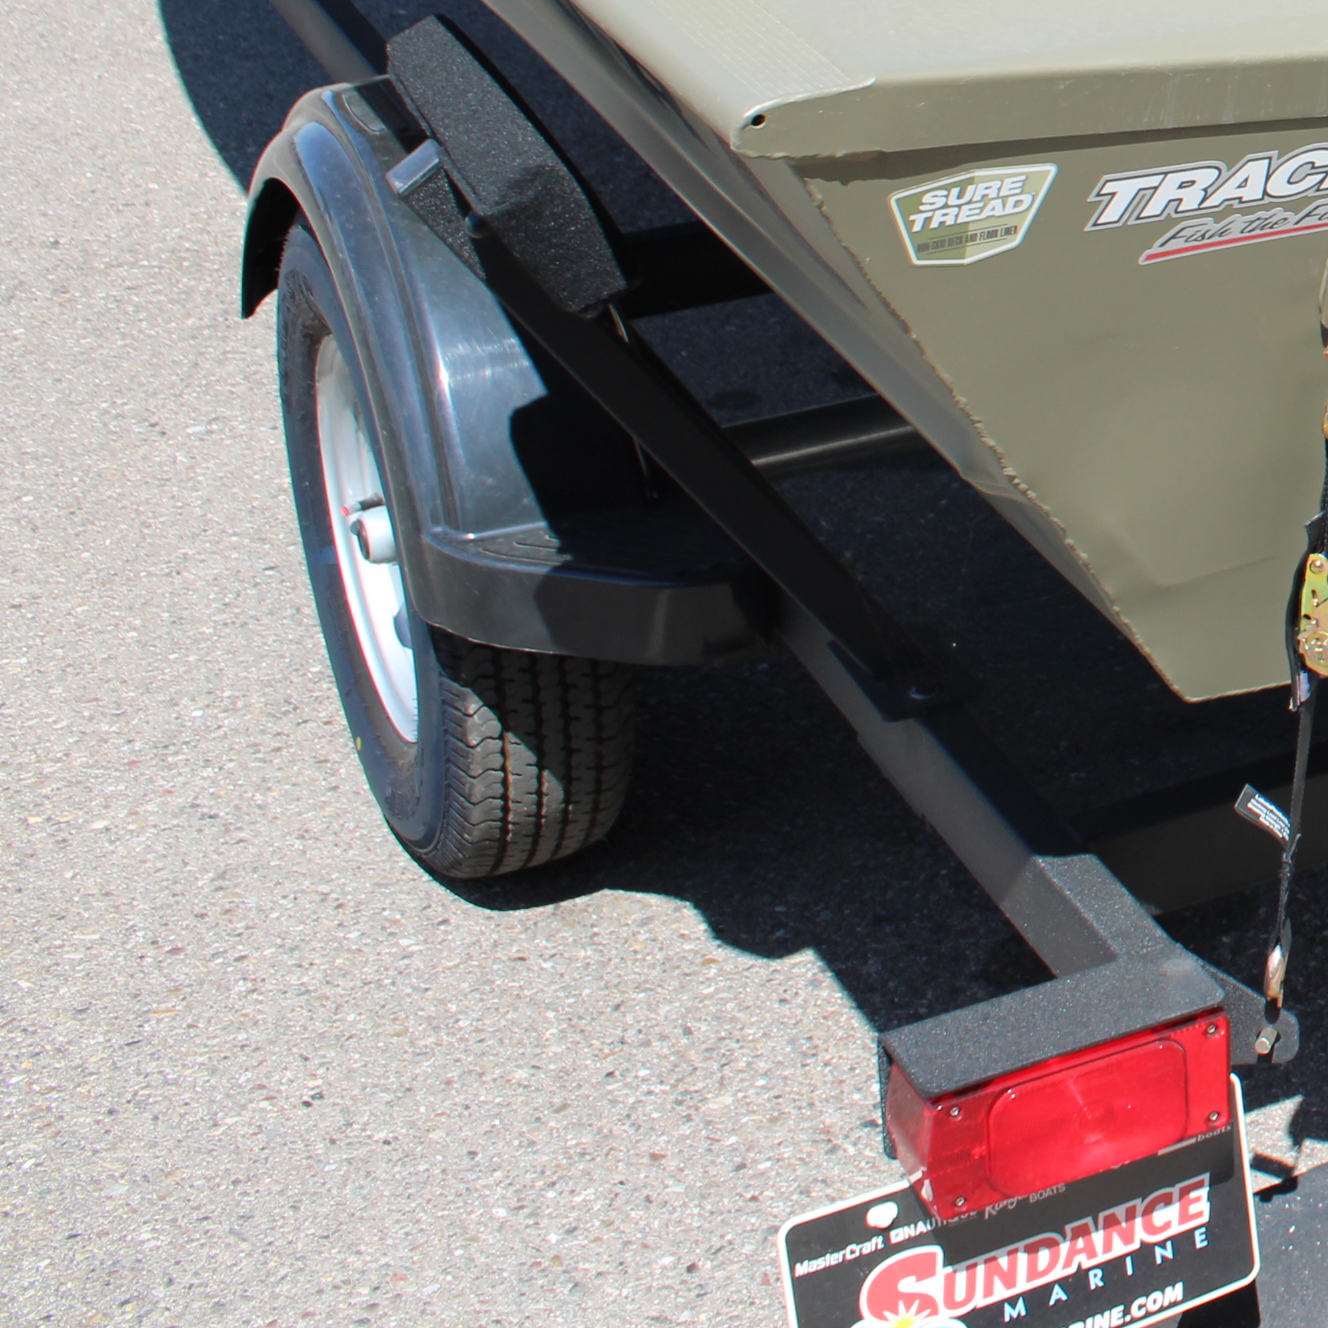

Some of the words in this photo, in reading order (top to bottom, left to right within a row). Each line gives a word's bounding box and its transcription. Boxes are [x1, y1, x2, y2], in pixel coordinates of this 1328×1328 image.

[909, 193, 1034, 233] TREAD
[919, 175, 1028, 212] SURE
[1158, 222, 1234, 249] Fish
[1239, 210, 1291, 234] the
[794, 1234, 885, 1278] MasterCraft
[1028, 1182, 1067, 1204] BOATS
[860, 1171, 1212, 1323] SUNDANCE
[1003, 1226, 1209, 1324] MARINE
